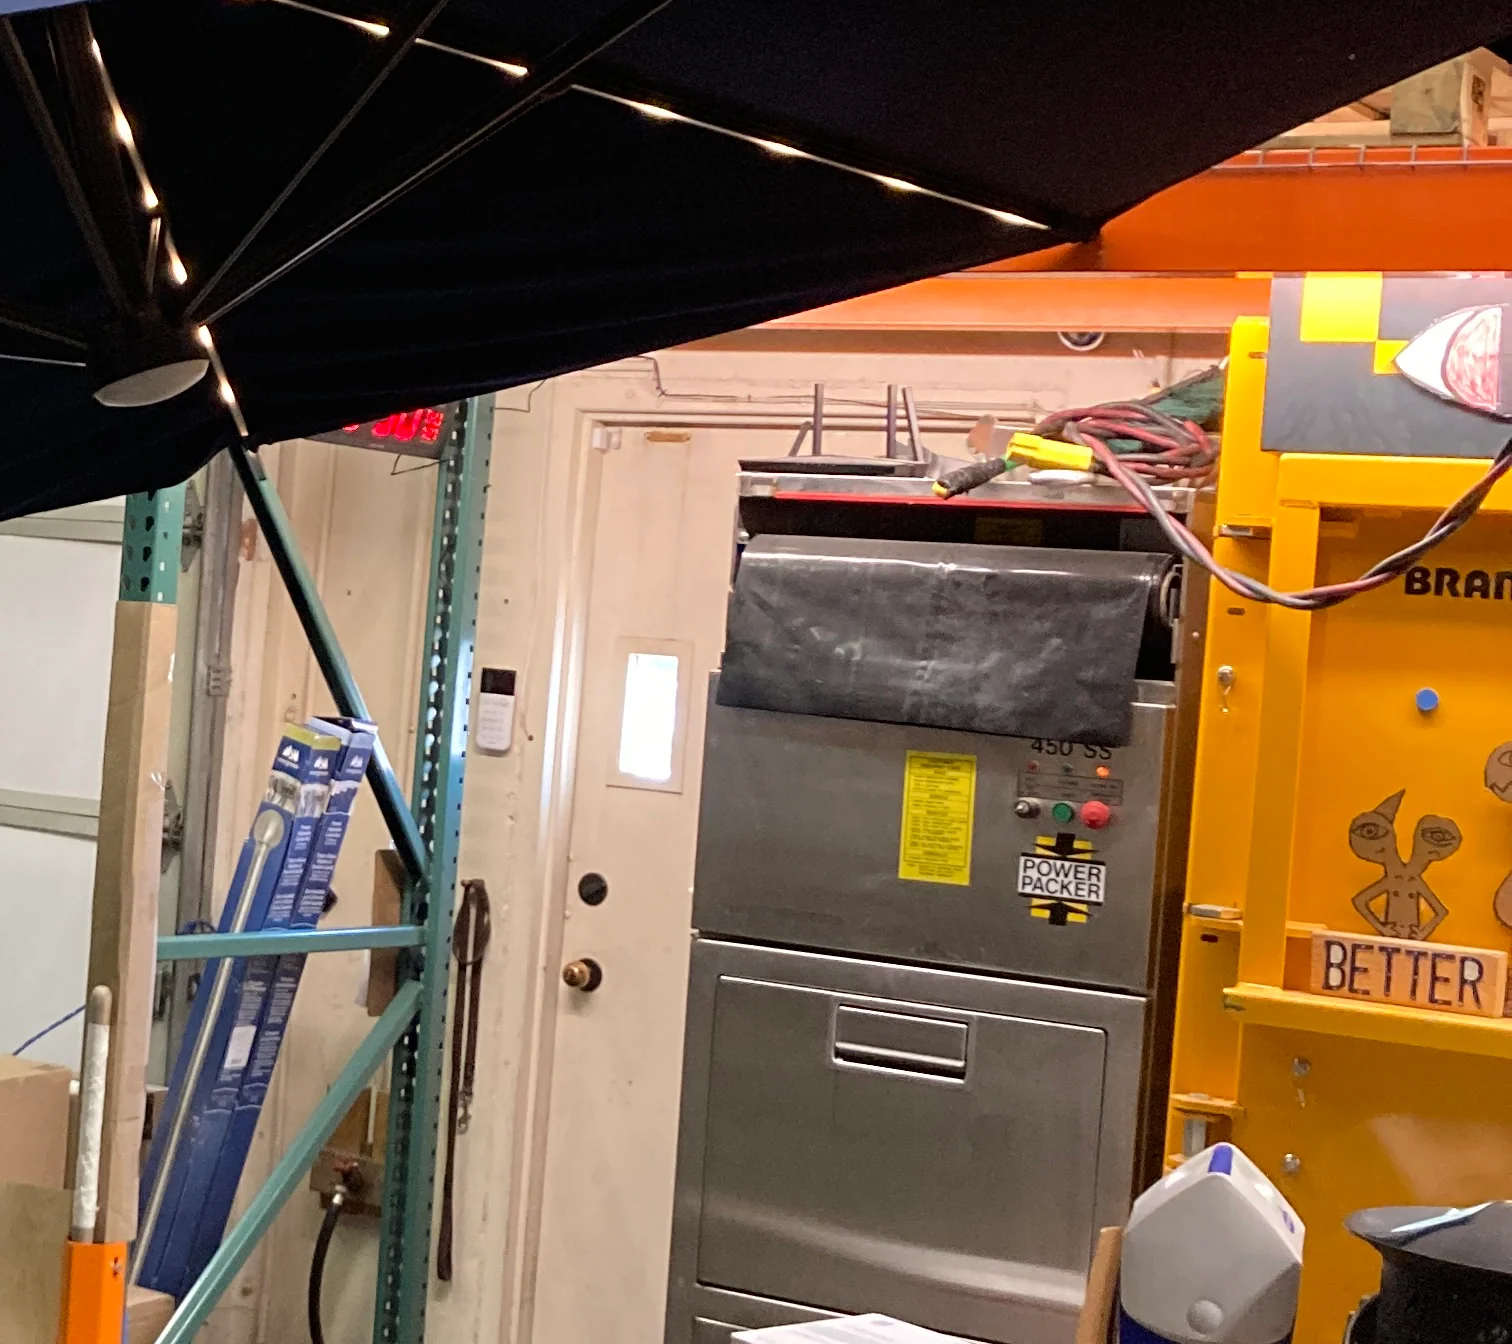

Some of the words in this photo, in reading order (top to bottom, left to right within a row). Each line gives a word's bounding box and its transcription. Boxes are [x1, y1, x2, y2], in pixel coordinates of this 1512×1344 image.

[1031, 738, 1073, 757] 450
[1084, 743, 1113, 760] SS
[1023, 858, 1102, 883] POWER
[1021, 875, 1101, 900] PACKER
[1322, 939, 1483, 1009] BETTER
